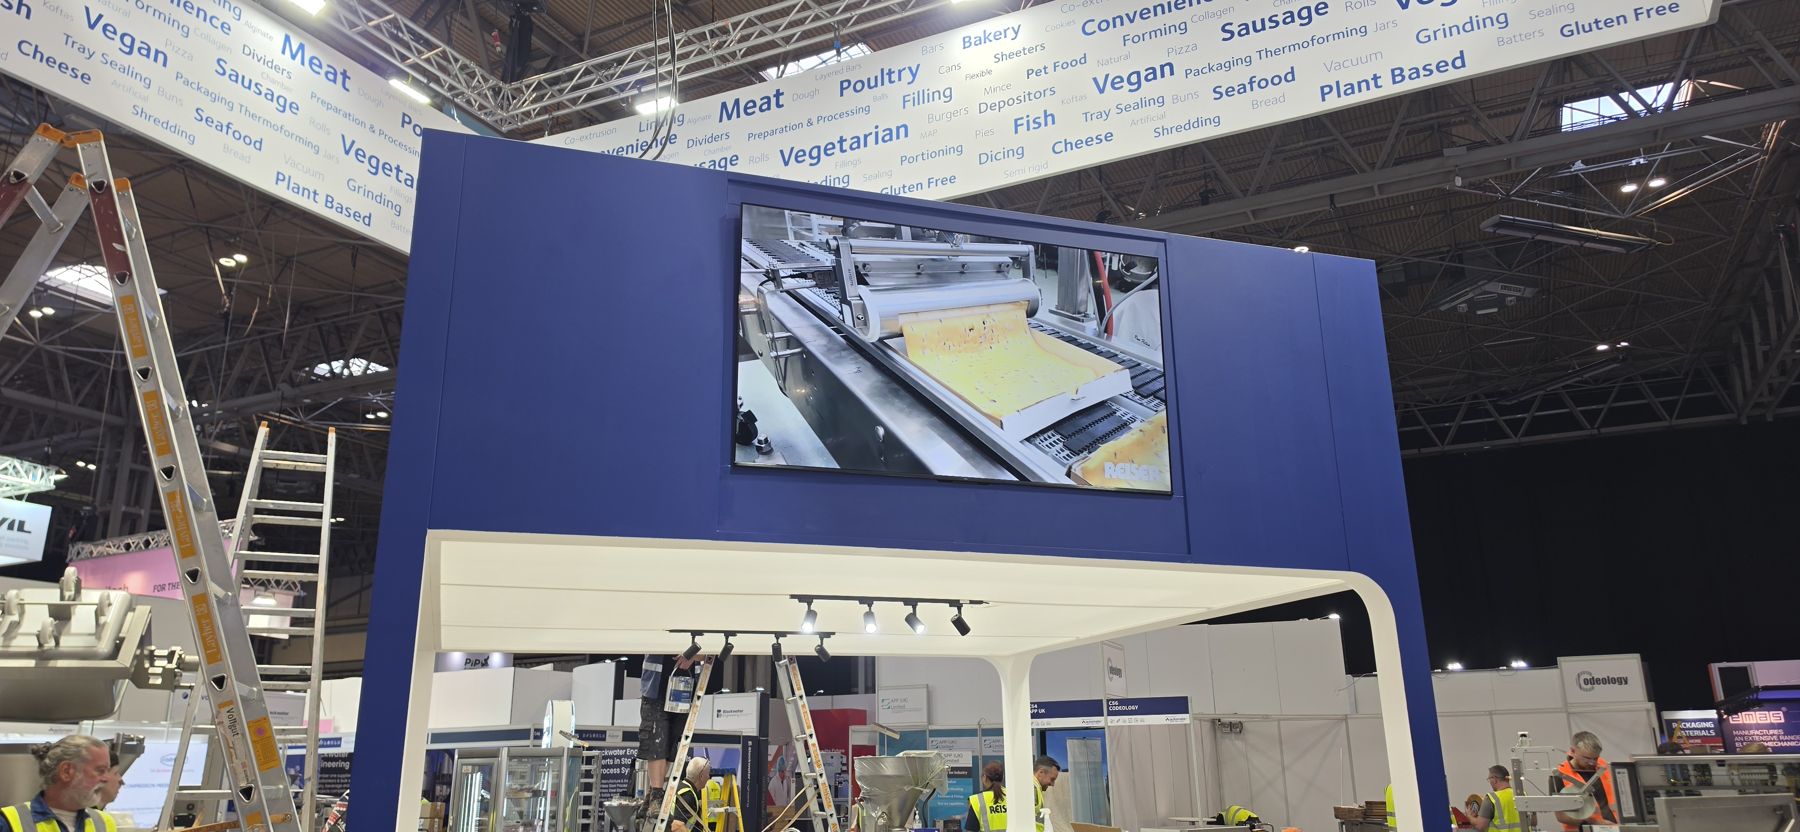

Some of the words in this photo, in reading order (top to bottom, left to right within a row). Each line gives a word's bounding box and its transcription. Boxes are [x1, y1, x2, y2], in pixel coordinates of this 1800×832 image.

[1191, 5, 1236, 24] Collagen
[1344, 0, 1377, 12] Rolls
[1528, 1, 1575, 20] Sealing
[125, 0, 190, 38] orming
[1220, 2, 1329, 42] Sausage
[1373, 19, 1398, 33] Jars
[1416, 12, 1509, 44] Grinding
[1560, 13, 1628, 38] Gluten
[1634, 1, 1680, 21] Free
[84, 5, 169, 69] Vegan
[962, 24, 1022, 50] Bakery
[1122, 21, 1188, 47] Forming
[1496, 27, 1545, 47] Batters
[63, 33, 95, 61] Tray
[100, 52, 152, 90] Sealing
[165, 38, 194, 62] Pizza
[921, 43, 945, 56] Bars
[993, 42, 1046, 64] Sheeters
[1097, 52, 1131, 68] Natural
[1167, 42, 1198, 58] Pizza
[1184, 54, 1252, 79] Packaging
[1256, 25, 1368, 61] Thermoforming
[1323, 50, 1384, 73] Vacuum
[17, 39, 92, 86] Cheese
[242, 43, 293, 81] Dividers
[281, 33, 351, 93] Meat
[938, 62, 962, 75] Cans
[1026, 66, 1049, 80] Pet
[1053, 53, 1088, 73] Food
[215, 57, 300, 116] Sausage
[839, 64, 921, 97] Poultry
[965, 68, 993, 81] Flexible
[1092, 61, 1175, 95] Vegan
[1212, 66, 1296, 101] Seafood
[1320, 72, 1383, 102] Plant
[1391, 50, 1467, 85] Based
[157, 86, 184, 107] Buns
[792, 87, 820, 103] Dough
[902, 86, 953, 109] Filling
[978, 86, 1056, 114] Depositors
[983, 81, 1012, 97] Mince
[1171, 91, 1200, 105] Buns
[175, 71, 235, 113] Packaging
[238, 102, 320, 156] Thermoforming
[718, 88, 785, 124] Meat
[1082, 108, 1111, 123] Tray
[1115, 94, 1165, 115] Sealing
[1251, 93, 1286, 110] Bread
[131, 104, 196, 146] Shredding
[310, 91, 368, 131] Preparation
[369, 122, 377, 134] &
[378, 128, 420, 158] Processin
[747, 121, 804, 142] Preparation
[806, 118, 814, 128] &
[816, 104, 871, 125] Processing
[927, 106, 969, 124] Burgers
[1013, 109, 1057, 135] Fish
[1130, 111, 1167, 127] Artificial
[1153, 114, 1221, 138] Shredding
[194, 107, 263, 152] Seafood
[564, 126, 618, 146] Co-extrusion
[687, 129, 731, 149] Dividers
[975, 128, 995, 139] Pies
[600, 133, 677, 157] venience
[779, 123, 909, 167] Vegetarian
[900, 144, 963, 166] Portioning
[978, 146, 1025, 165] Dicing
[1051, 131, 1114, 156] Cheese
[283, 153, 326, 182] Vacuum
[748, 152, 771, 165] Rolls
[346, 177, 402, 217] Grinding
[880, 176, 923, 196] Gluten
[927, 175, 957, 189] Free
[275, 171, 319, 205] Plant
[324, 194, 372, 228] Based
[1672, 721, 1714, 729] PCKAGING
[989, 804, 1008, 814] REIS
